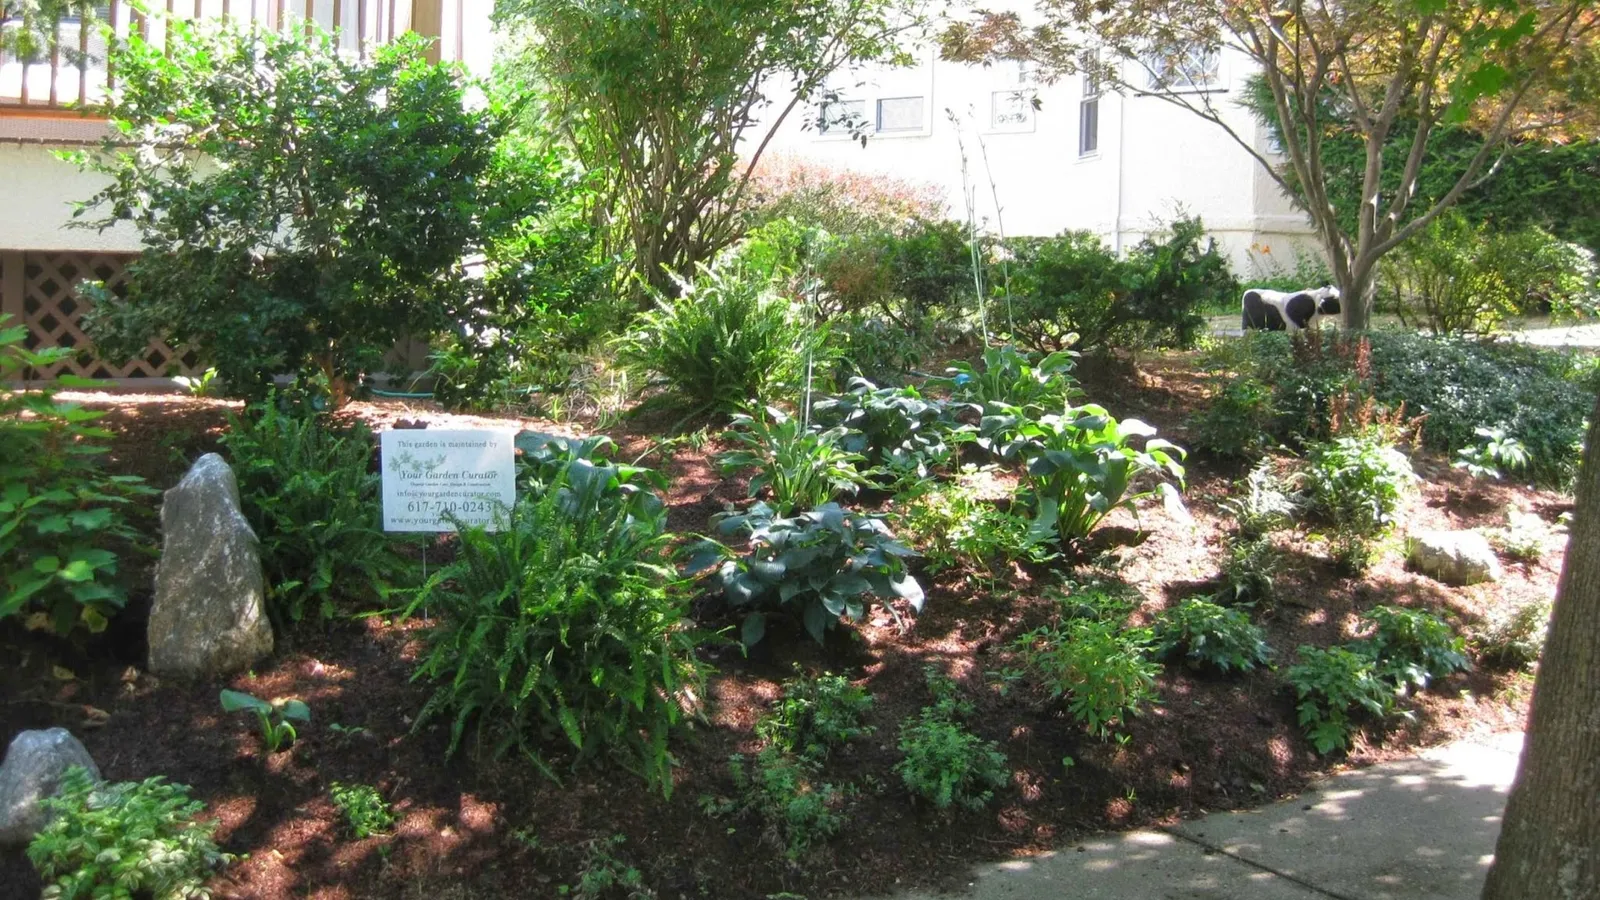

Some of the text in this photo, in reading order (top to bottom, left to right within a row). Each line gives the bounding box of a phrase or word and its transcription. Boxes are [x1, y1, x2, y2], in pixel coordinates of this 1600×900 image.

[414, 441, 438, 449] garden
[489, 441, 498, 449] by
[401, 470, 498, 480] Your Garden Curator
[407, 501, 492, 512] 617-710-0243
